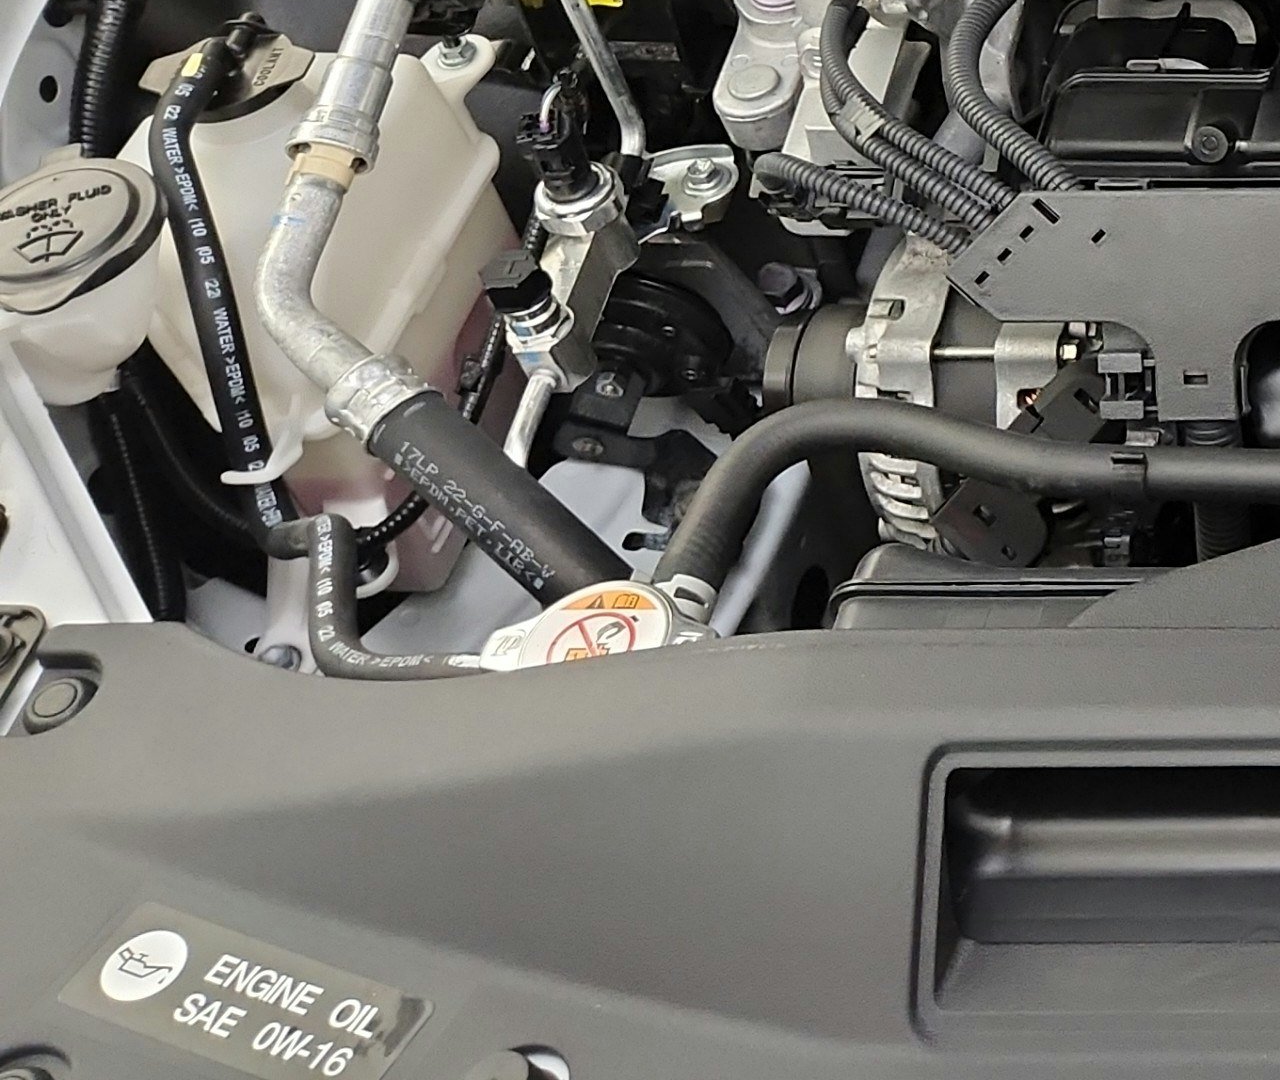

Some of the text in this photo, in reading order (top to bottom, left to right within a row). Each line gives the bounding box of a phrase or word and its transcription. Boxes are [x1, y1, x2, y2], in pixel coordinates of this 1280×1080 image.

[253, 47, 285, 87] COOLANT
[31, 204, 72, 223] ONLY
[67, 184, 112, 203] FLUID
[162, 126, 184, 166] WATER
[213, 306, 236, 355] WATER
[328, 641, 372, 666] WATER
[203, 953, 379, 1040] ENGINE OIL
[172, 993, 354, 1077] SAE 0W-16
